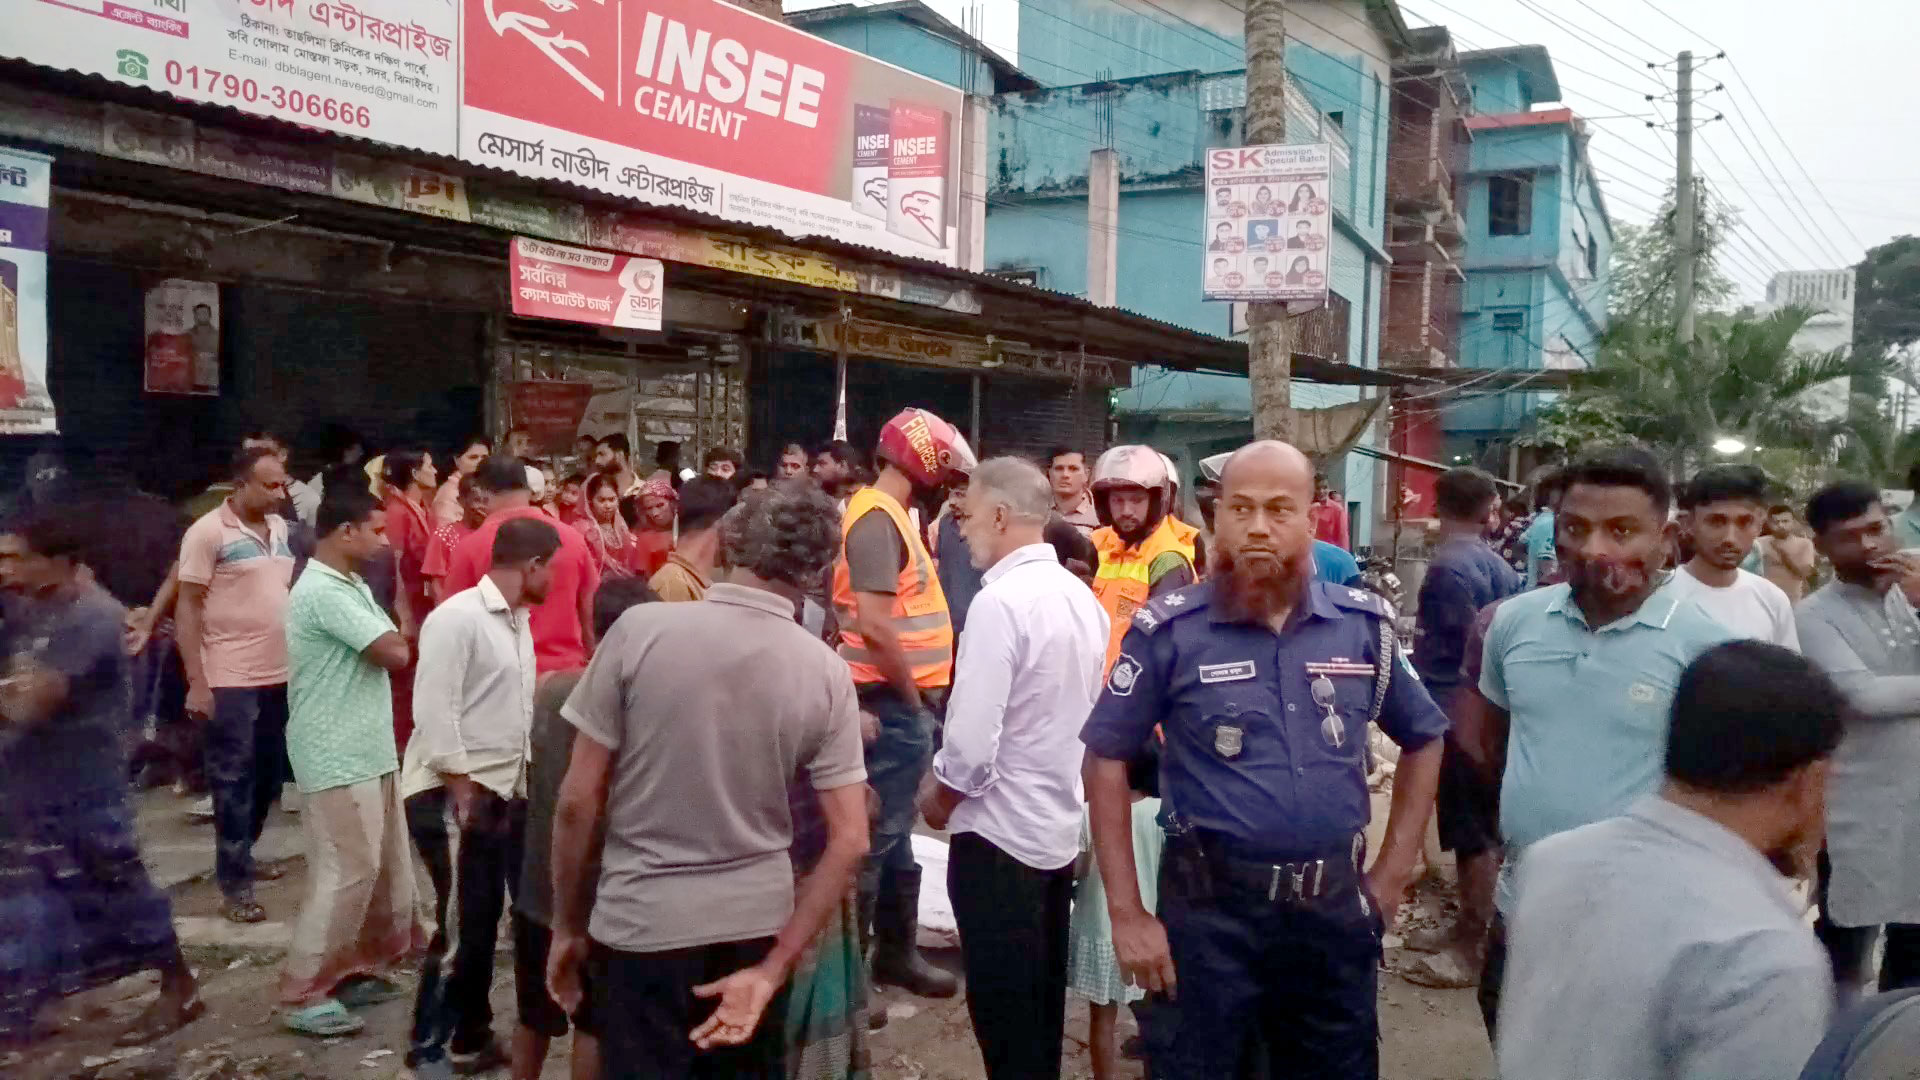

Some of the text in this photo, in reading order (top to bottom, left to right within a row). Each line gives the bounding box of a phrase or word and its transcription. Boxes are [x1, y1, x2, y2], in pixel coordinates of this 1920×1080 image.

[635, 11, 826, 129] INSEE
[164, 59, 372, 129] 01790-306666
[633, 85, 748, 142] CEMENT
[893, 136, 937, 157] INSEE
[477, 131, 715, 206] মেসার্স নাভীদ এন্টারপ্রাইজ
[893, 156, 918, 166] CEMENT
[1211, 148, 1313, 170] SK Admission
[1264, 156, 1297, 165] Special
[567, 253, 581, 262] সব
[518, 263, 567, 288] সর্বনিম্ন
[519, 287, 550, 302] ক্যাশ
[552, 291, 586, 308] আউট
[629, 294, 661, 312] নগদ
[900, 415, 931, 450] FIRE
